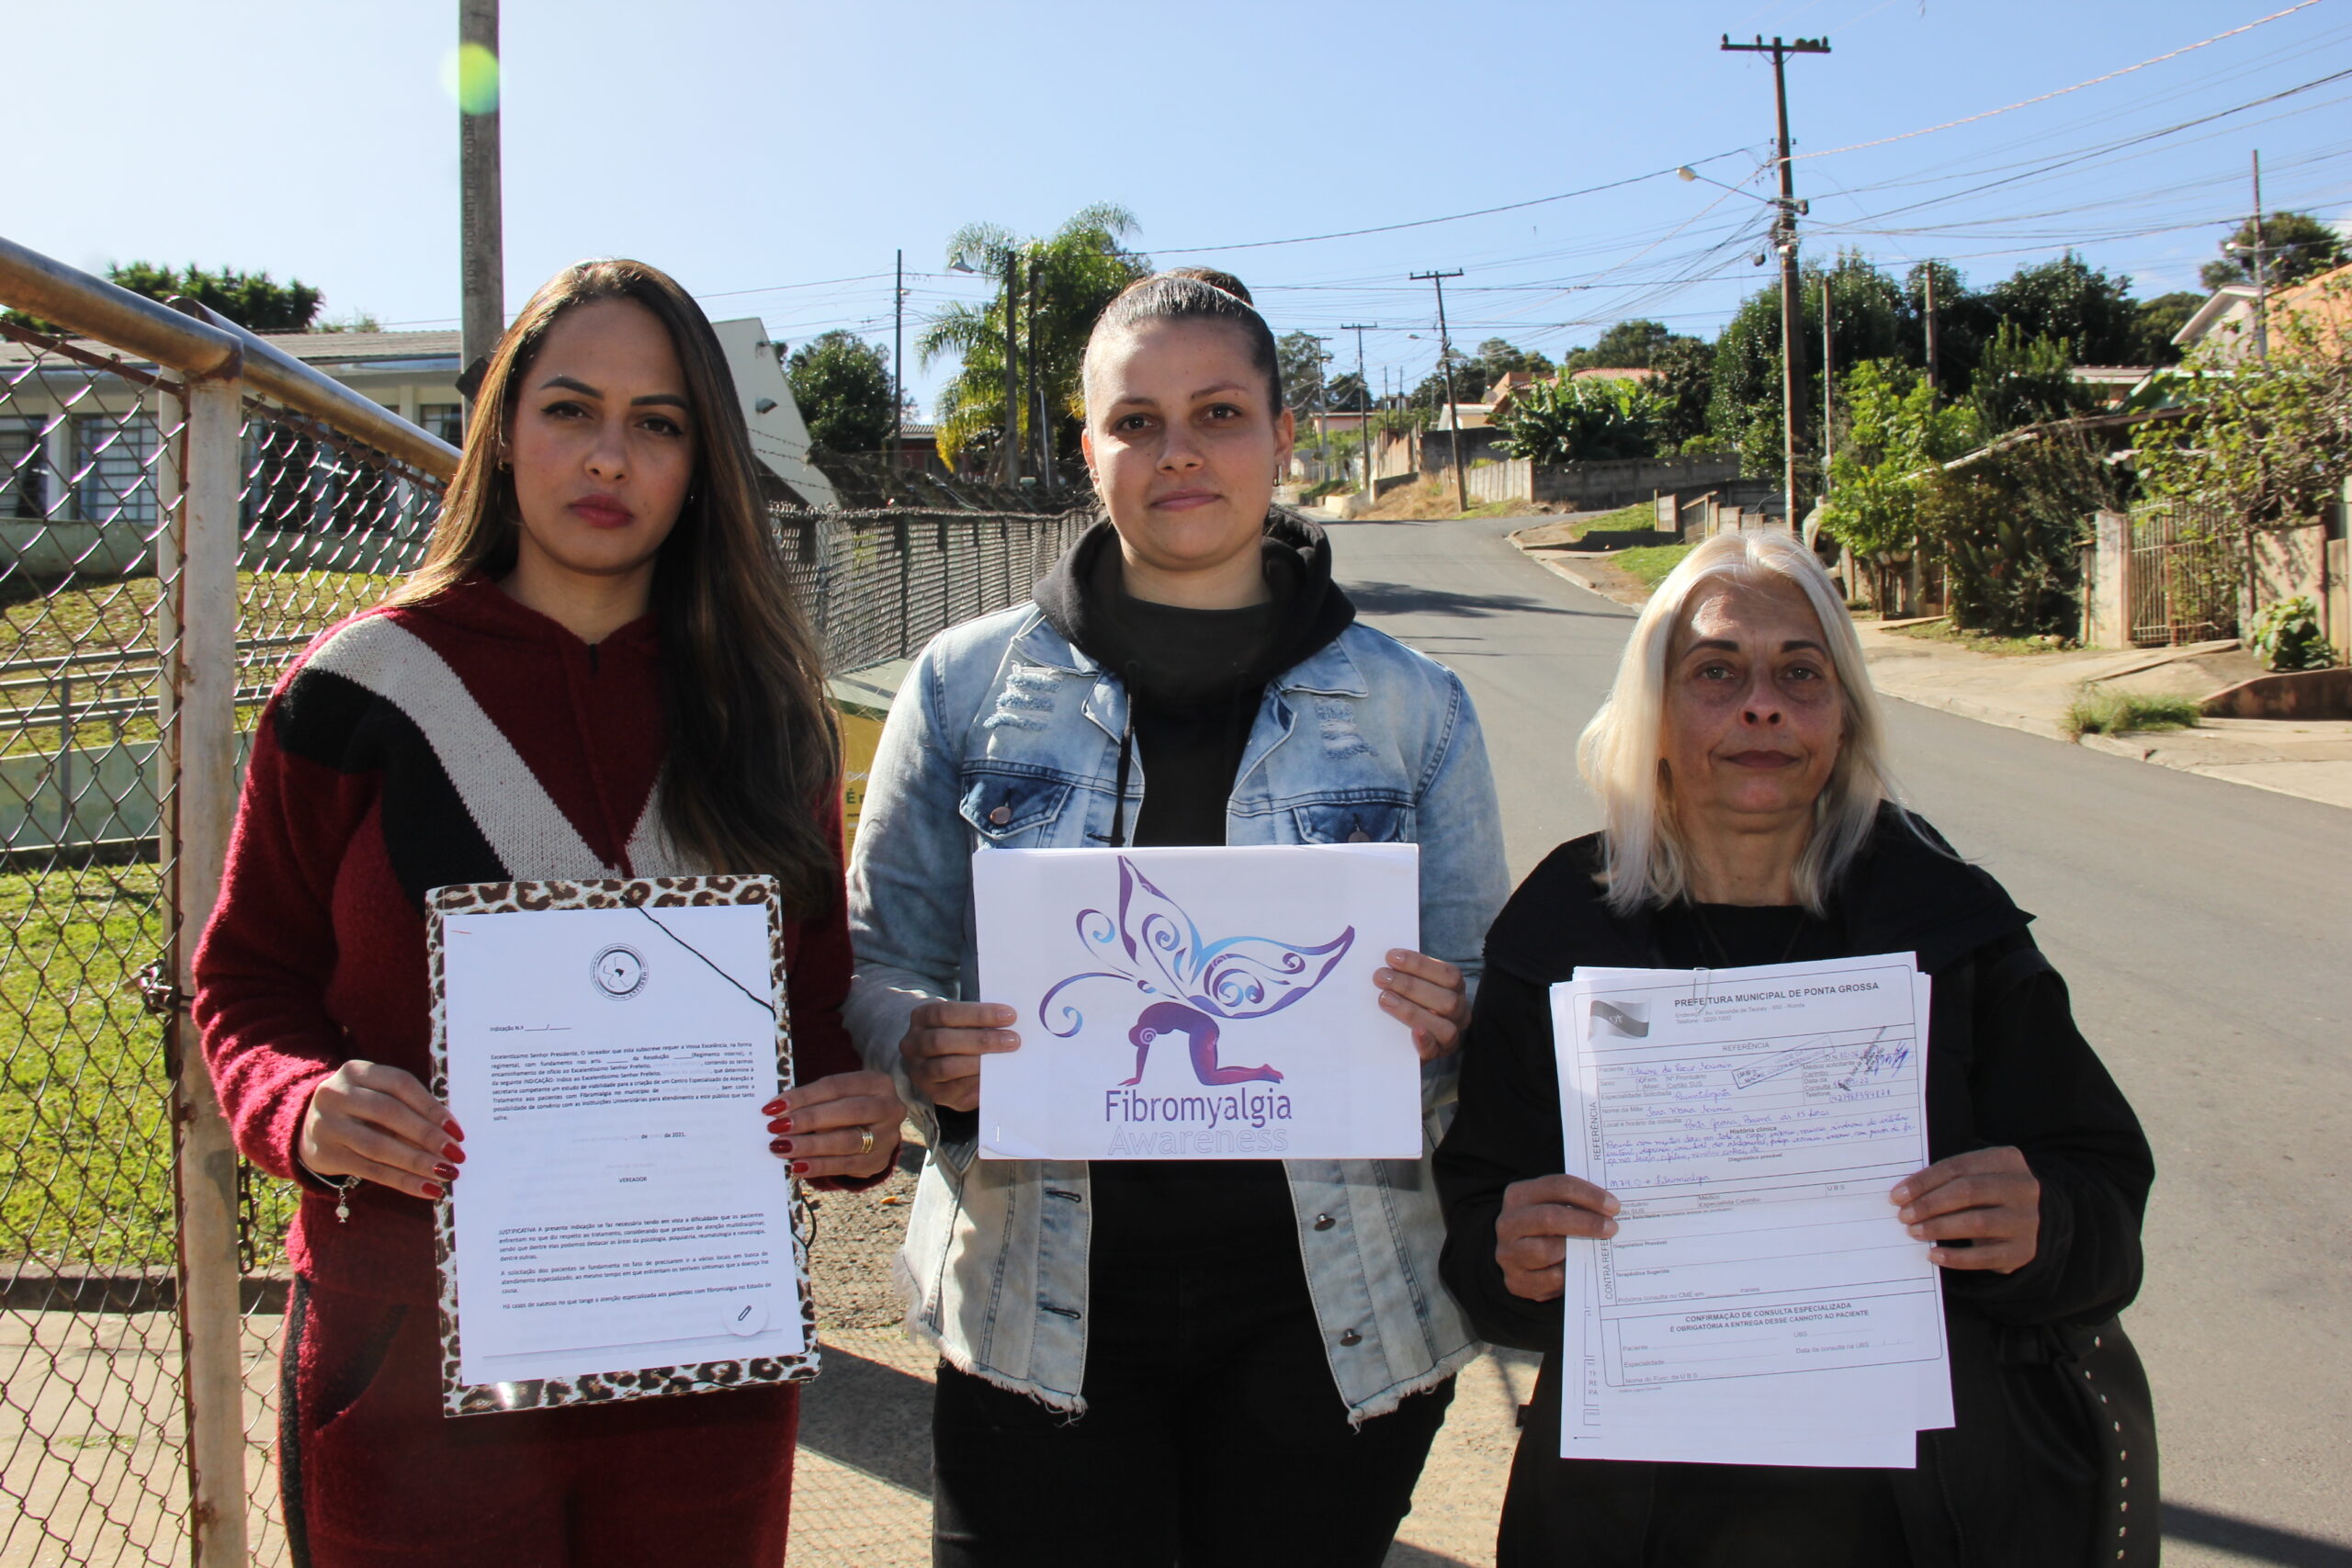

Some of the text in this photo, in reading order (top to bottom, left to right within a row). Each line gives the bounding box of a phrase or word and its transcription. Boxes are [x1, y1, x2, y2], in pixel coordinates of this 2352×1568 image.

[1674, 982, 1879, 1007] PREFEITURA MUNICIPAL DE PONTA GROSSA
[1722, 1041, 1770, 1052] REFERÊNCIA
[1105, 1088, 1293, 1128] Fibromyalgia
[1107, 1126, 1289, 1156] Awareness
[1589, 1101, 1601, 1161] REFERÊNCIA
[1602, 1264, 1613, 1300] CONTRA
[1675, 1321, 1724, 1332] OBRIGATÓRIA
[1729, 1319, 1764, 1327] ENTREGA
[1788, 1314, 1823, 1322] CANHOTO
[1835, 1310, 1869, 1318] PACIENTE
[1684, 1311, 1740, 1325] CONFIRMAÇÃO
[1753, 1307, 1792, 1317] CONSULTA
[1793, 1303, 1851, 1314] ESPECIALIZADA
